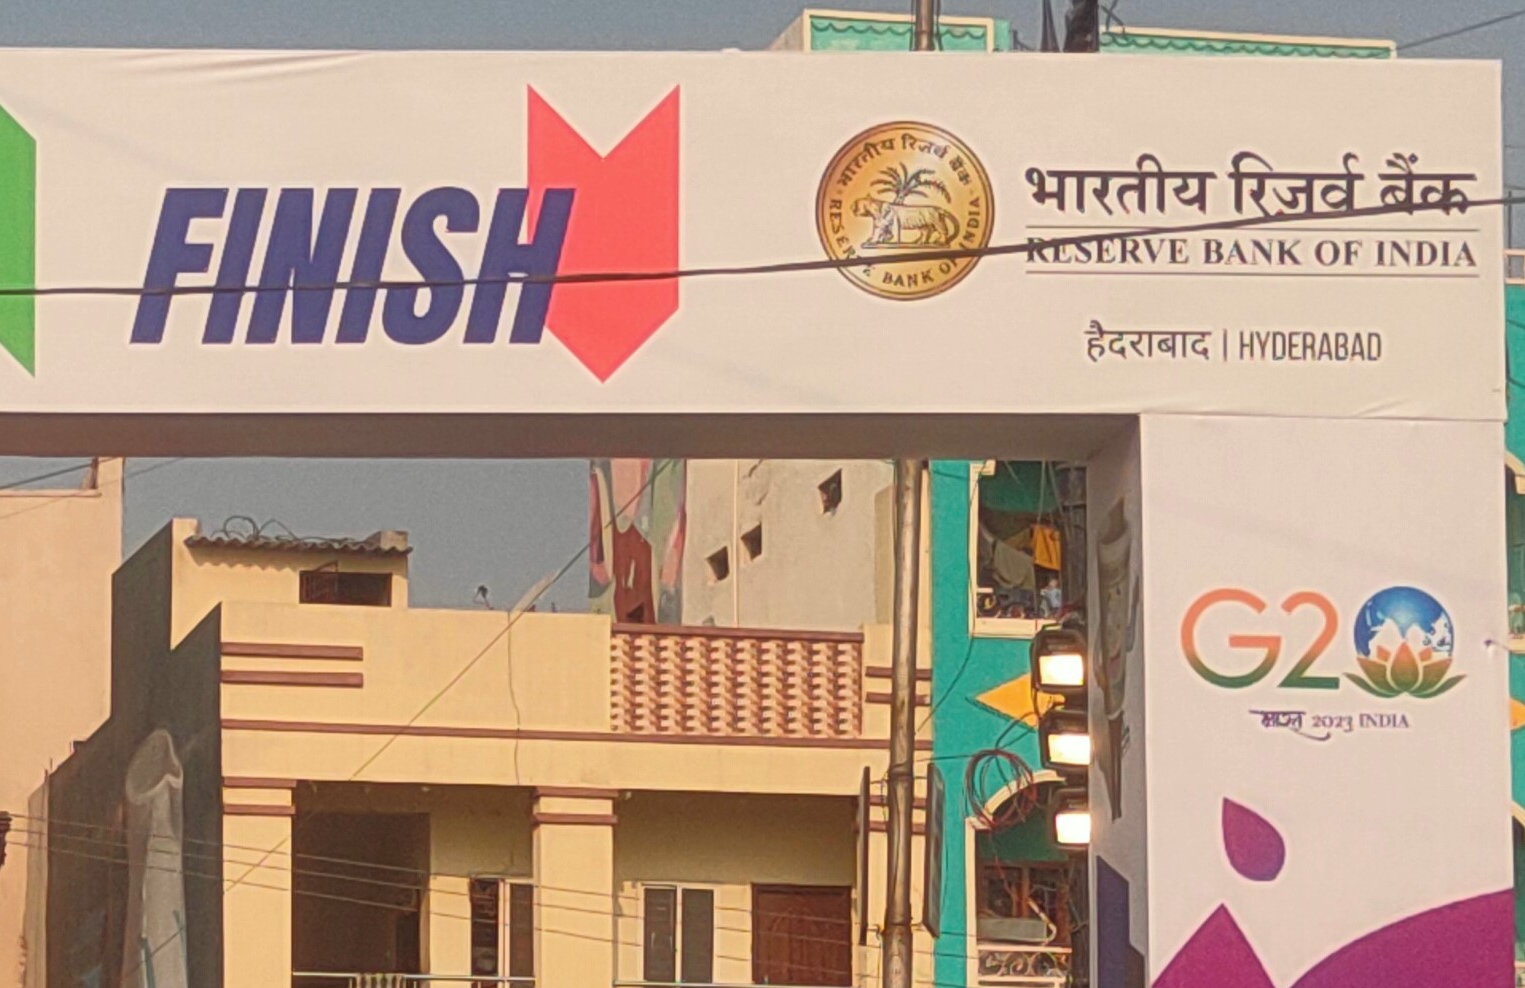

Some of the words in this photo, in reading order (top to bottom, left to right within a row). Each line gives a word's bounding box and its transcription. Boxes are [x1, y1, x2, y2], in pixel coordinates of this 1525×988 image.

[1025, 153, 1218, 216] भारतीय
[1378, 152, 1477, 215] बैंक
[128, 186, 577, 345] FINISH
[1026, 238, 1190, 265] RESERVE
[1203, 238, 1302, 266] BANK
[1315, 240, 1364, 266] OF
[1374, 240, 1477, 267] INDIA
[882, 270, 935, 288] BANK
[1084, 319, 1212, 362] हैदराबाद
[1239, 330, 1383, 361] HYDERABAD
[1312, 714, 1354, 732] 2023
[1359, 713, 1410, 729] INDIA
